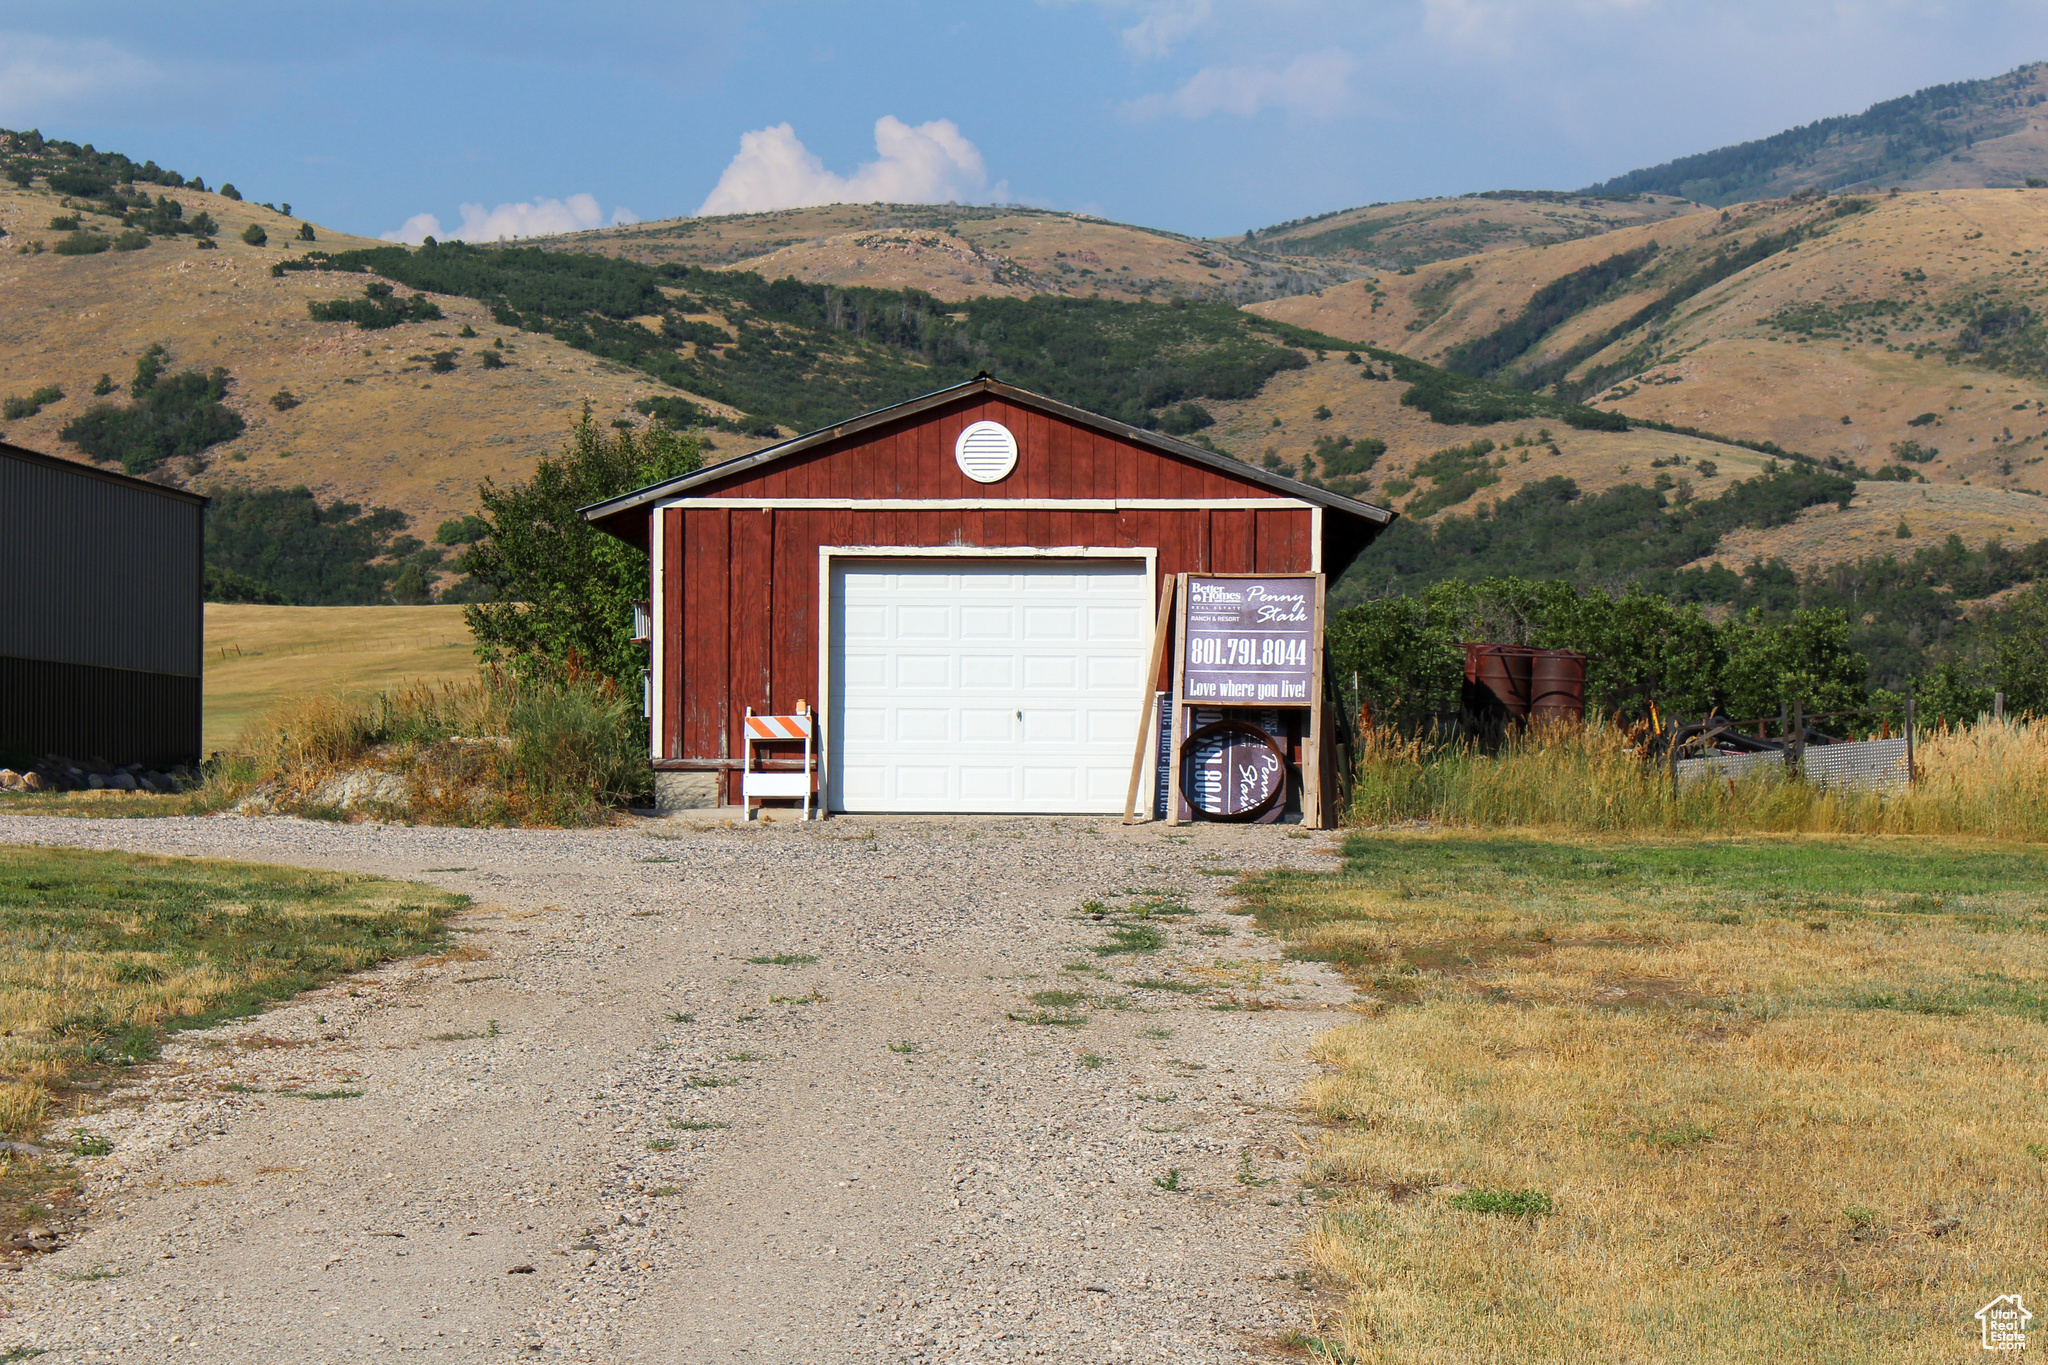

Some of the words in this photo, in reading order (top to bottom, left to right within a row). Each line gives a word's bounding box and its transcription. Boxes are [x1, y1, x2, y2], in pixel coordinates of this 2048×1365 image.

[1192, 583, 1225, 593] Better
[1202, 591, 1241, 603] Homes
[1246, 585, 1305, 612] Penny
[1257, 605, 1308, 623] Stark
[1191, 638, 1306, 666] 801.791.8044
[1189, 678, 1216, 697] Love
[1219, 679, 1255, 697] where
[1257, 684, 1278, 700] you
[1281, 680, 1306, 698] live!
